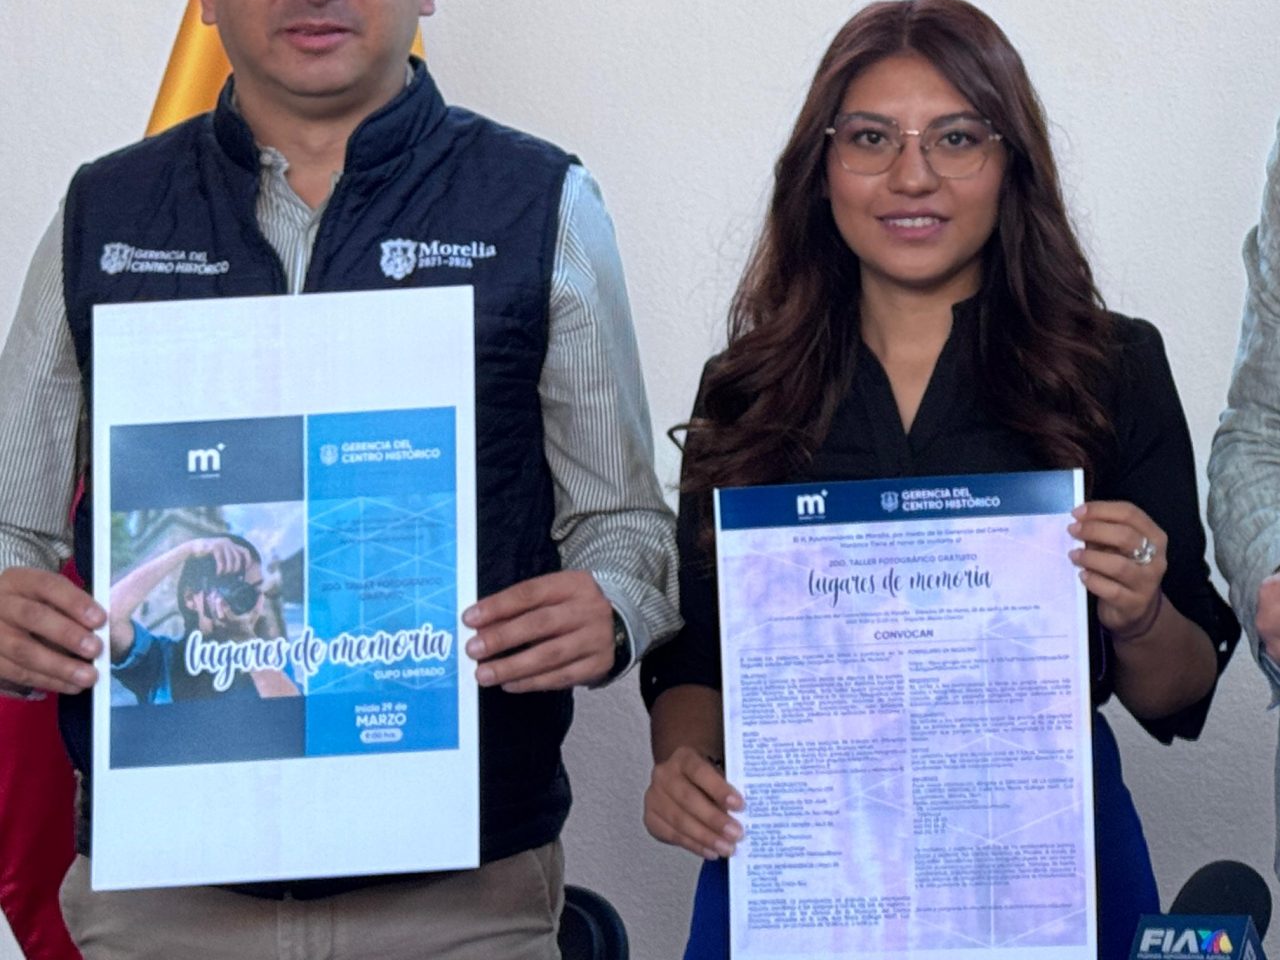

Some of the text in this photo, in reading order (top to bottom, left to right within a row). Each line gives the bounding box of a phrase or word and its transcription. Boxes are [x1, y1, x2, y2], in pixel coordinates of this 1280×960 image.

[419, 240, 497, 258] Morelia
[131, 261, 174, 273] CENTRO
[341, 439, 411, 452] GERENCIA DEL
[341, 452, 383, 464] CENTRO
[901, 487, 971, 500] GERENCIA DEL
[902, 495, 1001, 512] CENTRO HISTÓRICO
[808, 565, 993, 608] lugares de memoria
[873, 628, 934, 641] CONVOCAN
[186, 623, 452, 691] lugares de memoria
[373, 667, 446, 680] CUPO LIMITADO
[355, 712, 407, 728] MARZO
[1139, 928, 1199, 953] FIA
